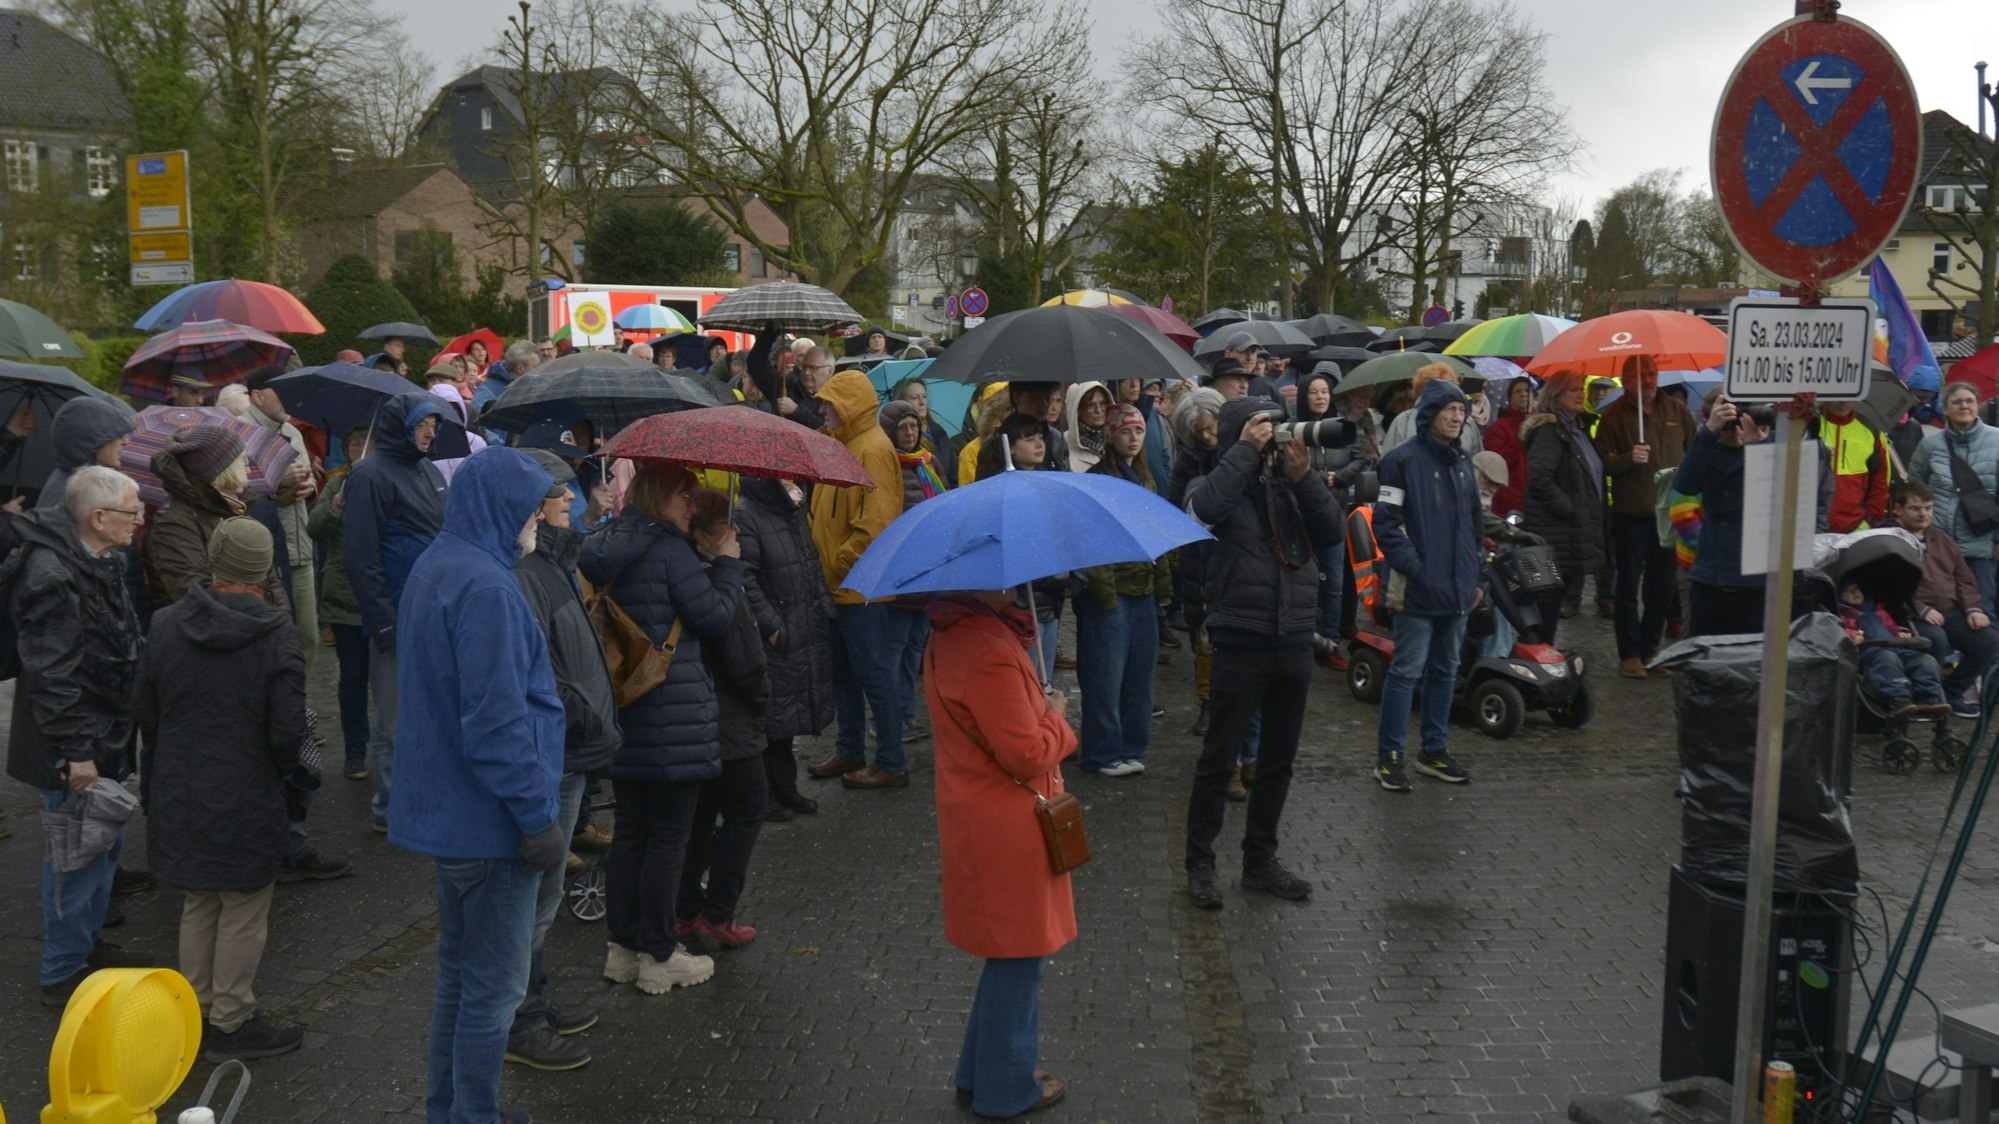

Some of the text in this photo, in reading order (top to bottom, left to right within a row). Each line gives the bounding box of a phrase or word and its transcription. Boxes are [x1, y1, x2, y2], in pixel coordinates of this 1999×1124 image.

[1749, 320, 1843, 348] Sa. 23.03.2024
[1736, 356, 1859, 383] 11.00 bis 15.00 Uhr
